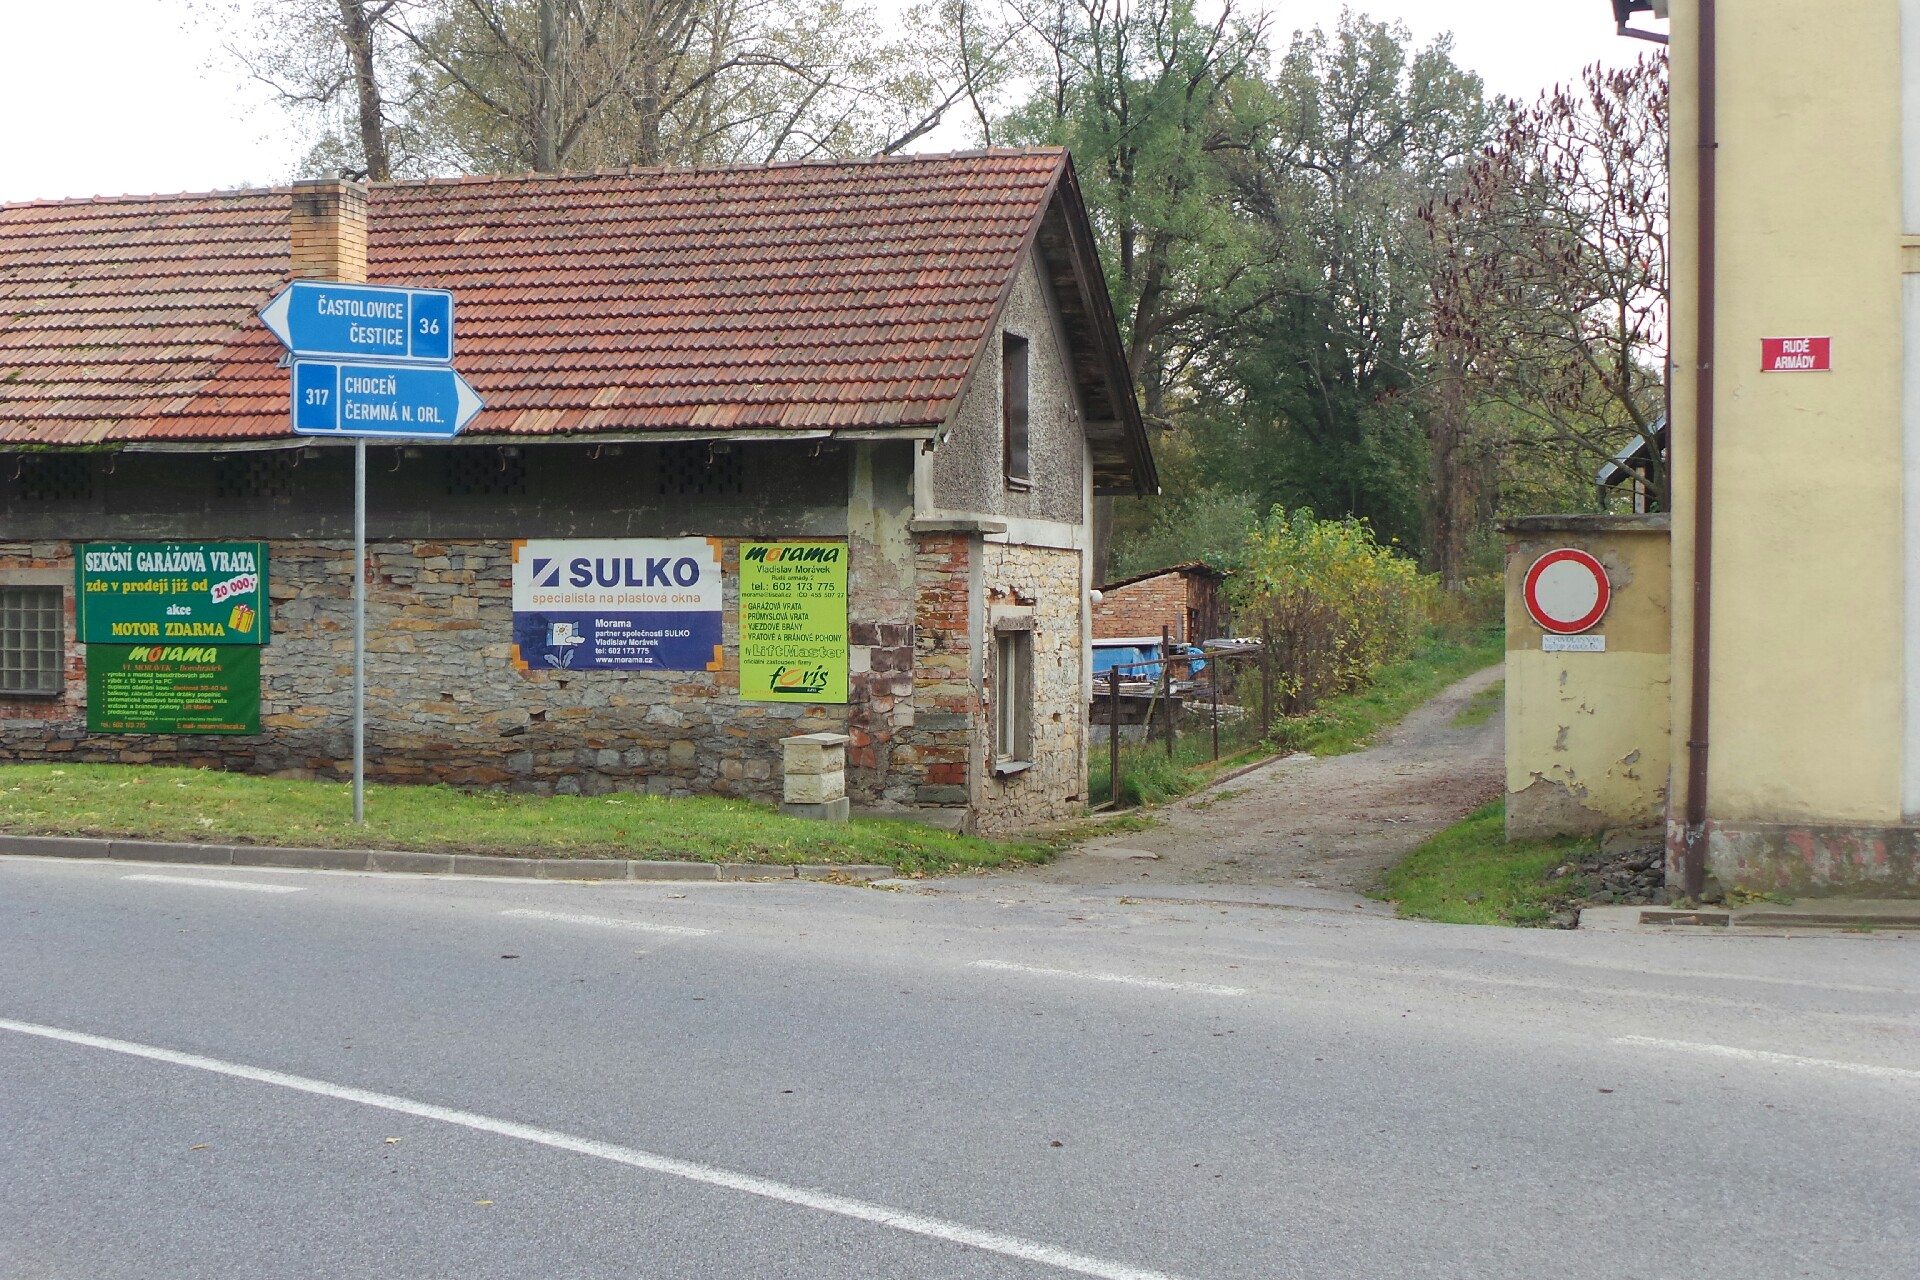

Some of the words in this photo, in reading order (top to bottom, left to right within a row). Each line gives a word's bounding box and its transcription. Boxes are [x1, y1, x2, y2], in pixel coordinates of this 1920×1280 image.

[318, 295, 403, 319] ČASTOLOVICE
[419, 318, 439, 334] 36
[350, 323, 403, 345] ČESTICE
[1783, 338, 1810, 353] RUDÉ
[1774, 354, 1815, 368] ARMÁDY
[345, 375, 396, 395] CHOCEŇ
[306, 389, 329, 405] 317
[345, 401, 398, 421] ČERMNÁ
[402, 406, 414, 422] N.
[418, 406, 445, 423] ORL.
[85, 546, 132, 572] SEKČNÍ
[136, 545, 207, 572] GARÁŽOVÁ
[210, 551, 256, 572] VRATA
[744, 547, 839, 563] morama
[569, 557, 700, 588] SULKO
[757, 565, 792, 574] Vladislav
[795, 565, 831, 574] Morávek
[86, 579, 108, 592] zde
[110, 582, 119, 591] v
[122, 579, 169, 594] prodeji
[171, 579, 188, 594] již
[191, 579, 208, 591] od
[214, 585, 228, 598] 20
[751, 582, 768, 591] tel.:
[772, 582, 791, 591] 602
[796, 582, 813, 591] 173
[817, 582, 835, 591] 775
[532, 592, 596, 604] specialista
[599, 594, 614, 603] na
[617, 592, 667, 605] plastová
[671, 593, 701, 603] okna
[166, 604, 192, 615] akce
[747, 602, 781, 611] GARÁŽOVÁ
[782, 602, 802, 611] VRATA
[747, 611, 788, 621] PRŮMYSLOVÁ
[789, 612, 809, 621] VRATA
[112, 622, 159, 636] MOTOR
[165, 622, 225, 636] ZDARMA
[595, 619, 631, 628] Morama
[747, 622, 780, 631] VJEZDOVÉ
[782, 622, 803, 631] BRÁNY
[595, 630, 620, 639] partner
[622, 629, 663, 639] společnosti
[747, 632, 776, 641] VRATOVÉ
[784, 633, 813, 642] BRÁNOVÉ
[815, 634, 842, 642] POHONY
[595, 638, 627, 646] Vladislav
[628, 638, 659, 646] Morávek
[128, 646, 217, 663] morama
[595, 656, 653, 664] www.morama.cz
